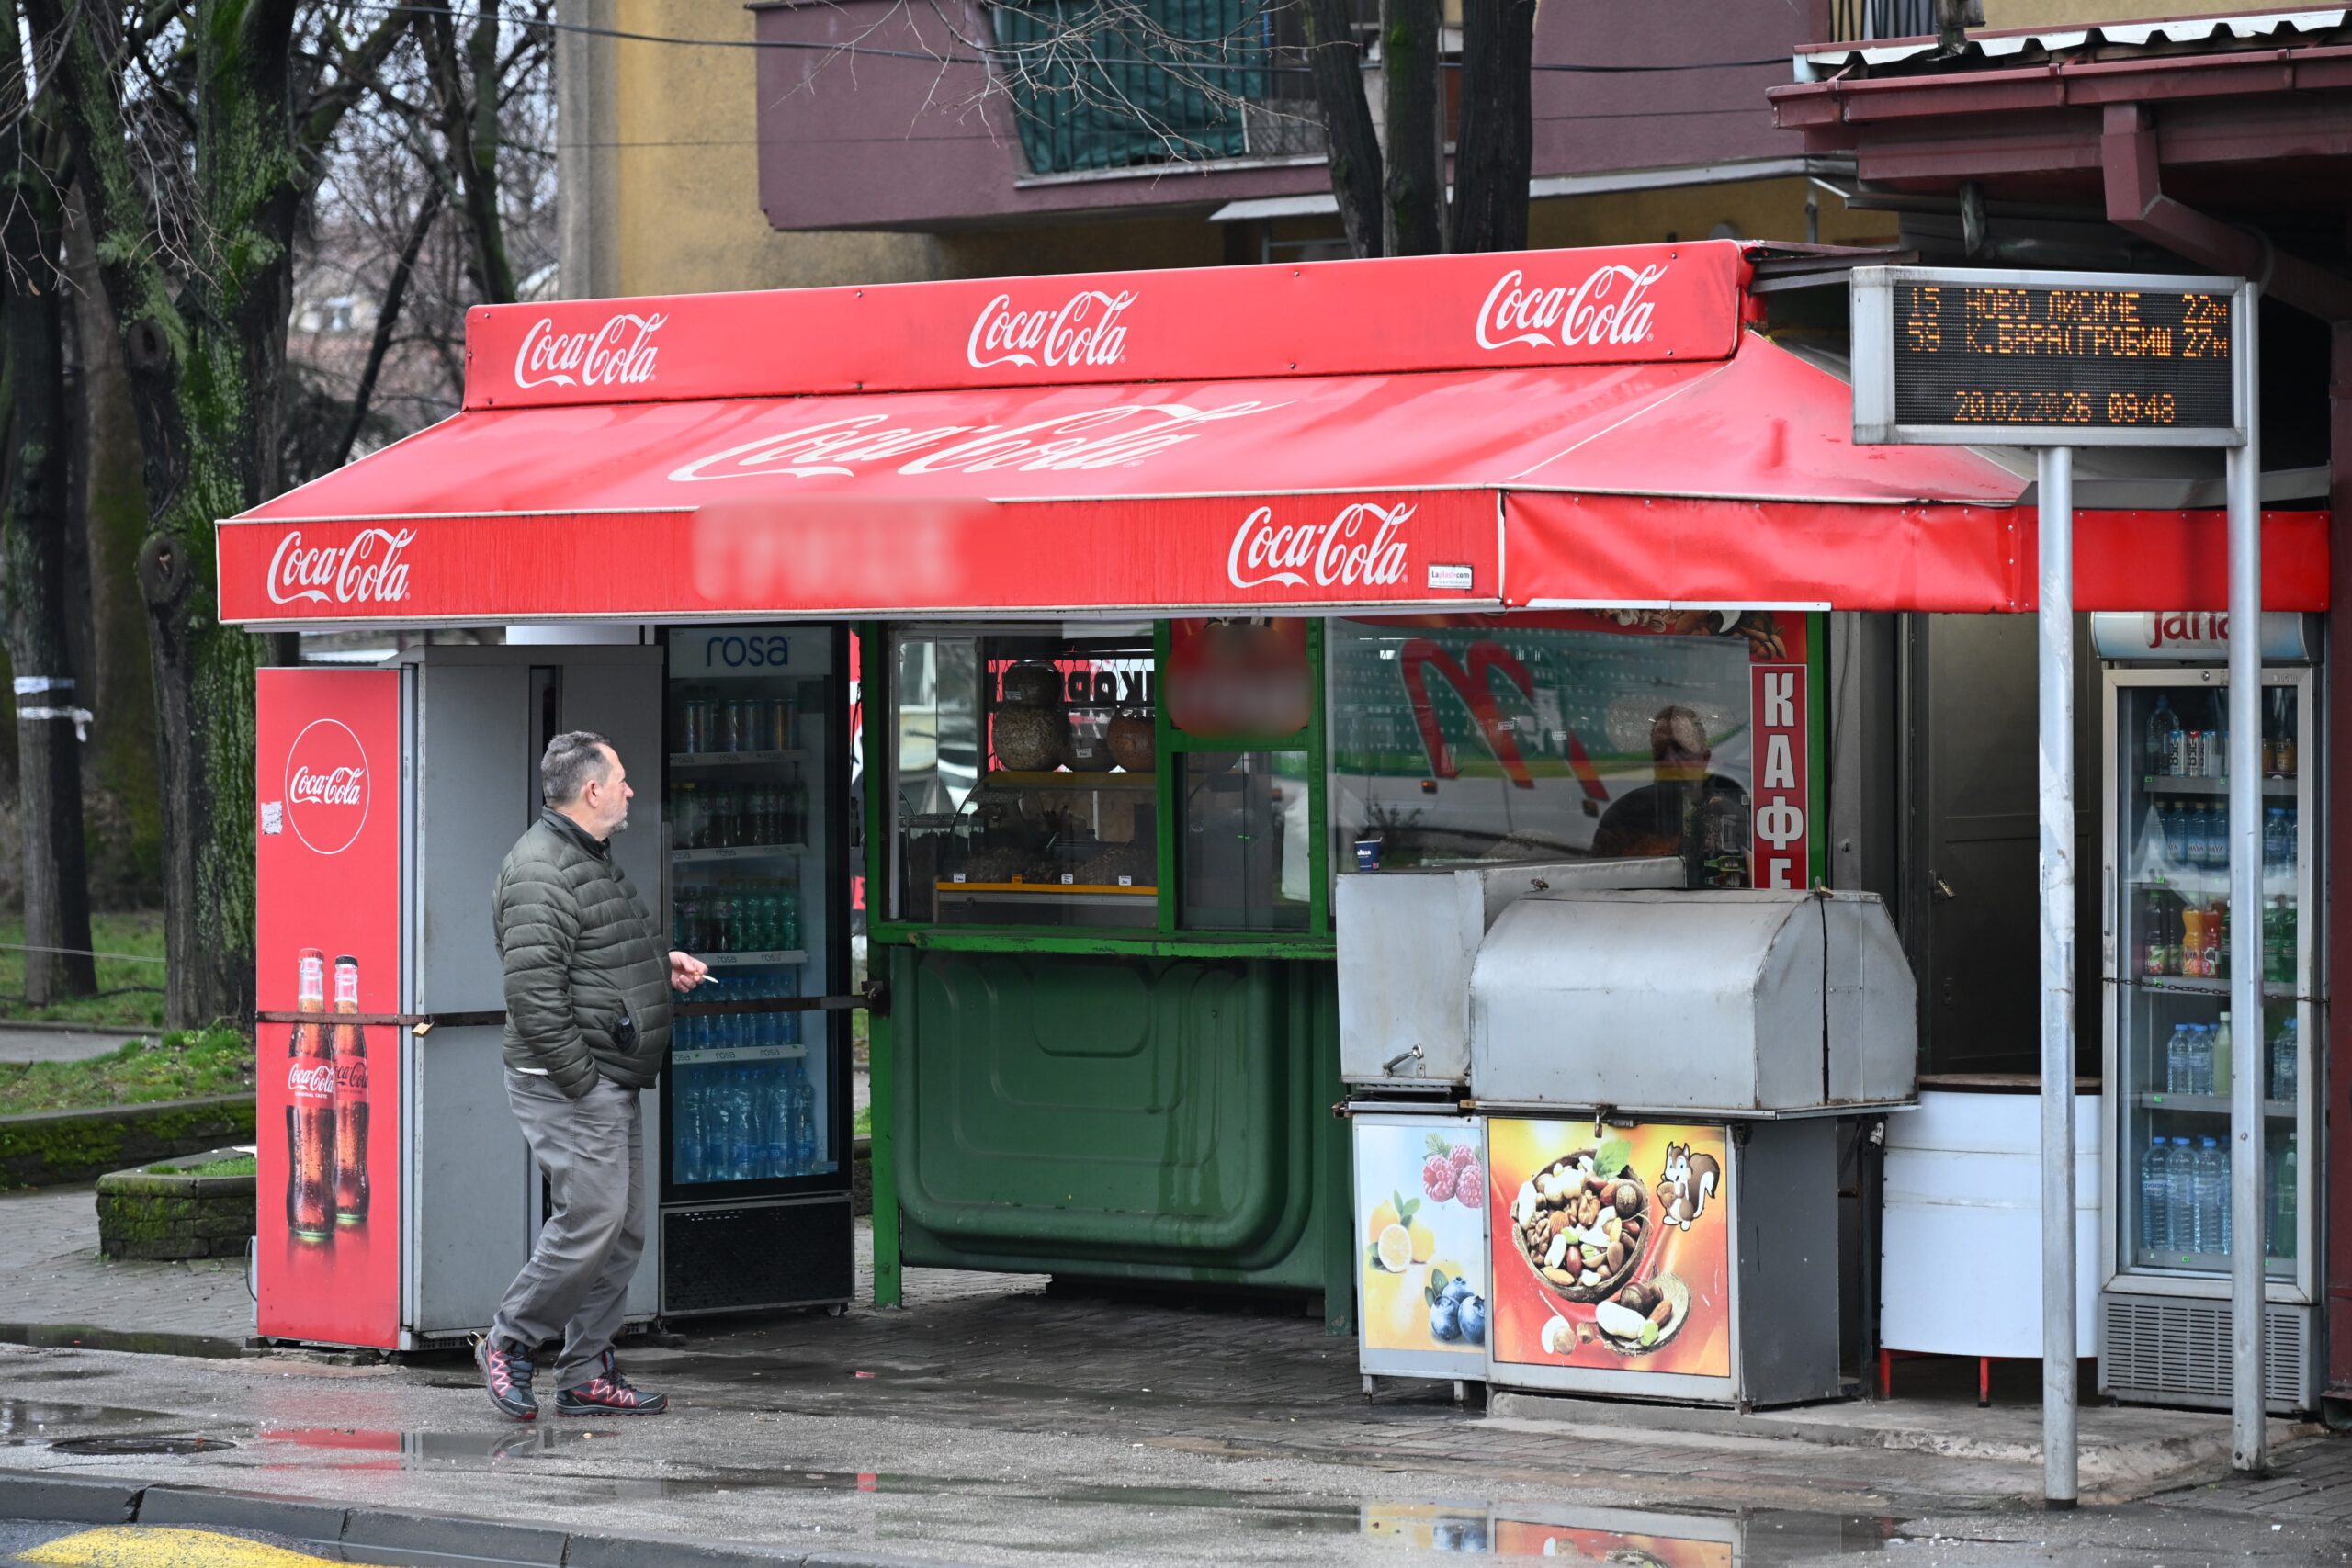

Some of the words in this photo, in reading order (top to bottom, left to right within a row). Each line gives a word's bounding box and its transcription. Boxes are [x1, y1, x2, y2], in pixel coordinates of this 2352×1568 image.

[1476, 264, 1668, 350] Coca-Cola
[1911, 287, 1940, 318] 15
[967, 289, 1139, 369] Coca-Cola
[1908, 321, 1940, 353] 59
[514, 312, 669, 389] Coca-Cola
[1954, 390, 2092, 423] 20.02.2026
[2108, 392, 2176, 423] 09:48
[666, 397, 1299, 482] Coca-Cola
[1227, 502, 1417, 589] Coca-Cola
[266, 528, 417, 604] Coca-Cola
[707, 635, 788, 667] rosa
[290, 766, 365, 805] Coca-Cola
[1756, 672, 1804, 889] КАФЕ
[717, 955, 737, 964] rosa
[715, 1050, 736, 1059] rosa
[760, 1048, 780, 1057] rosa
[288, 1063, 334, 1094] Coca-Cola
